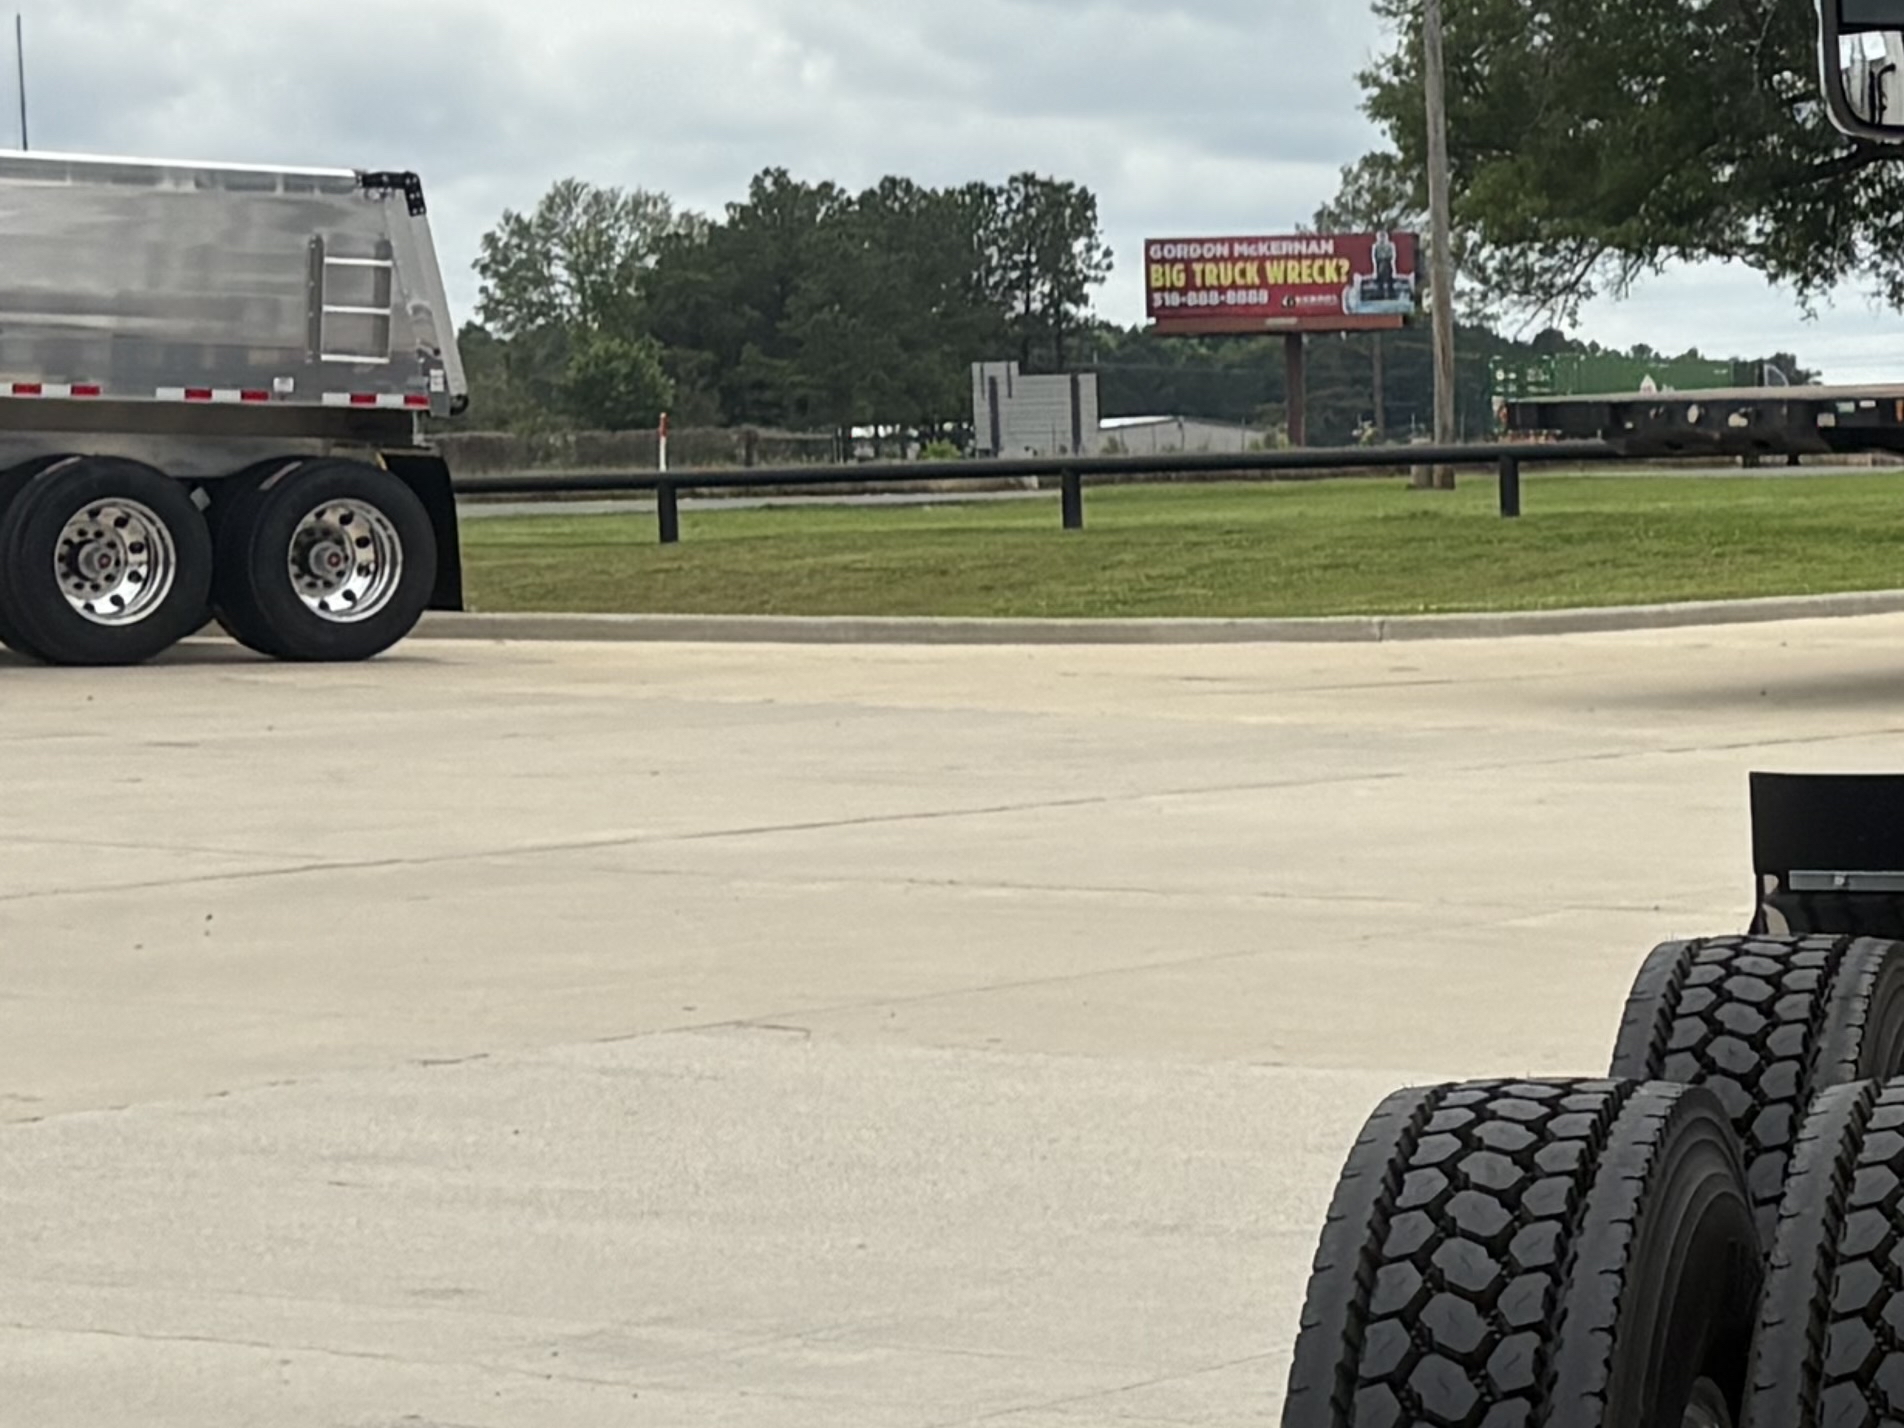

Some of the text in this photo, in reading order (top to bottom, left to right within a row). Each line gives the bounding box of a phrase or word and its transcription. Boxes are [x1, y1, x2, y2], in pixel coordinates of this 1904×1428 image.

[1149, 239, 1335, 260] GORDON McKERNAN
[1150, 258, 1350, 288] BIG TRUCK WRECK?
